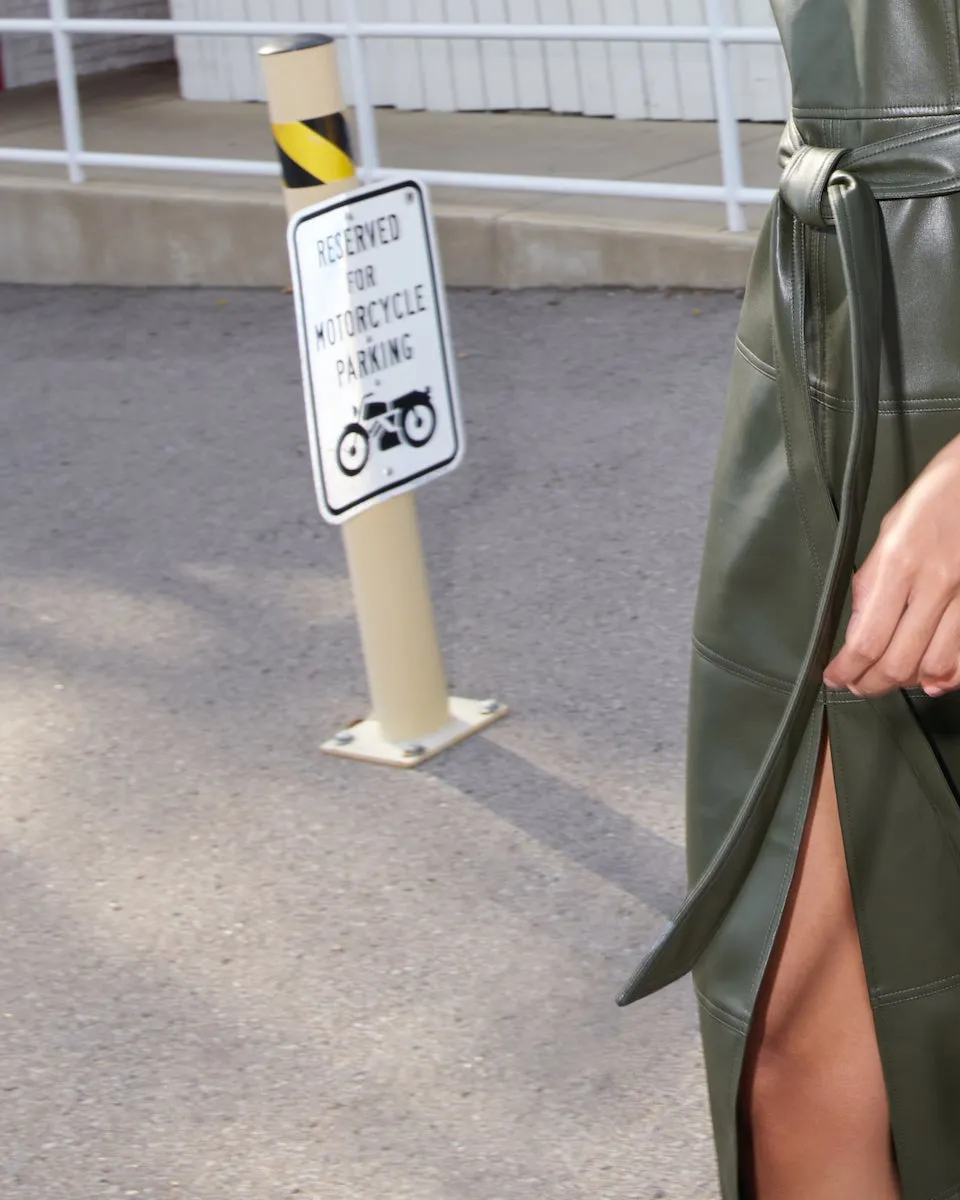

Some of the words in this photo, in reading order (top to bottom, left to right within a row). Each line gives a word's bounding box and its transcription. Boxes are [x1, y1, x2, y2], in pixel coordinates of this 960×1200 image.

[316, 214, 400, 268] RESERVED
[346, 265, 376, 293] FOR
[315, 284, 427, 350] MOTORCYCLE
[336, 333, 414, 387] PARKING
